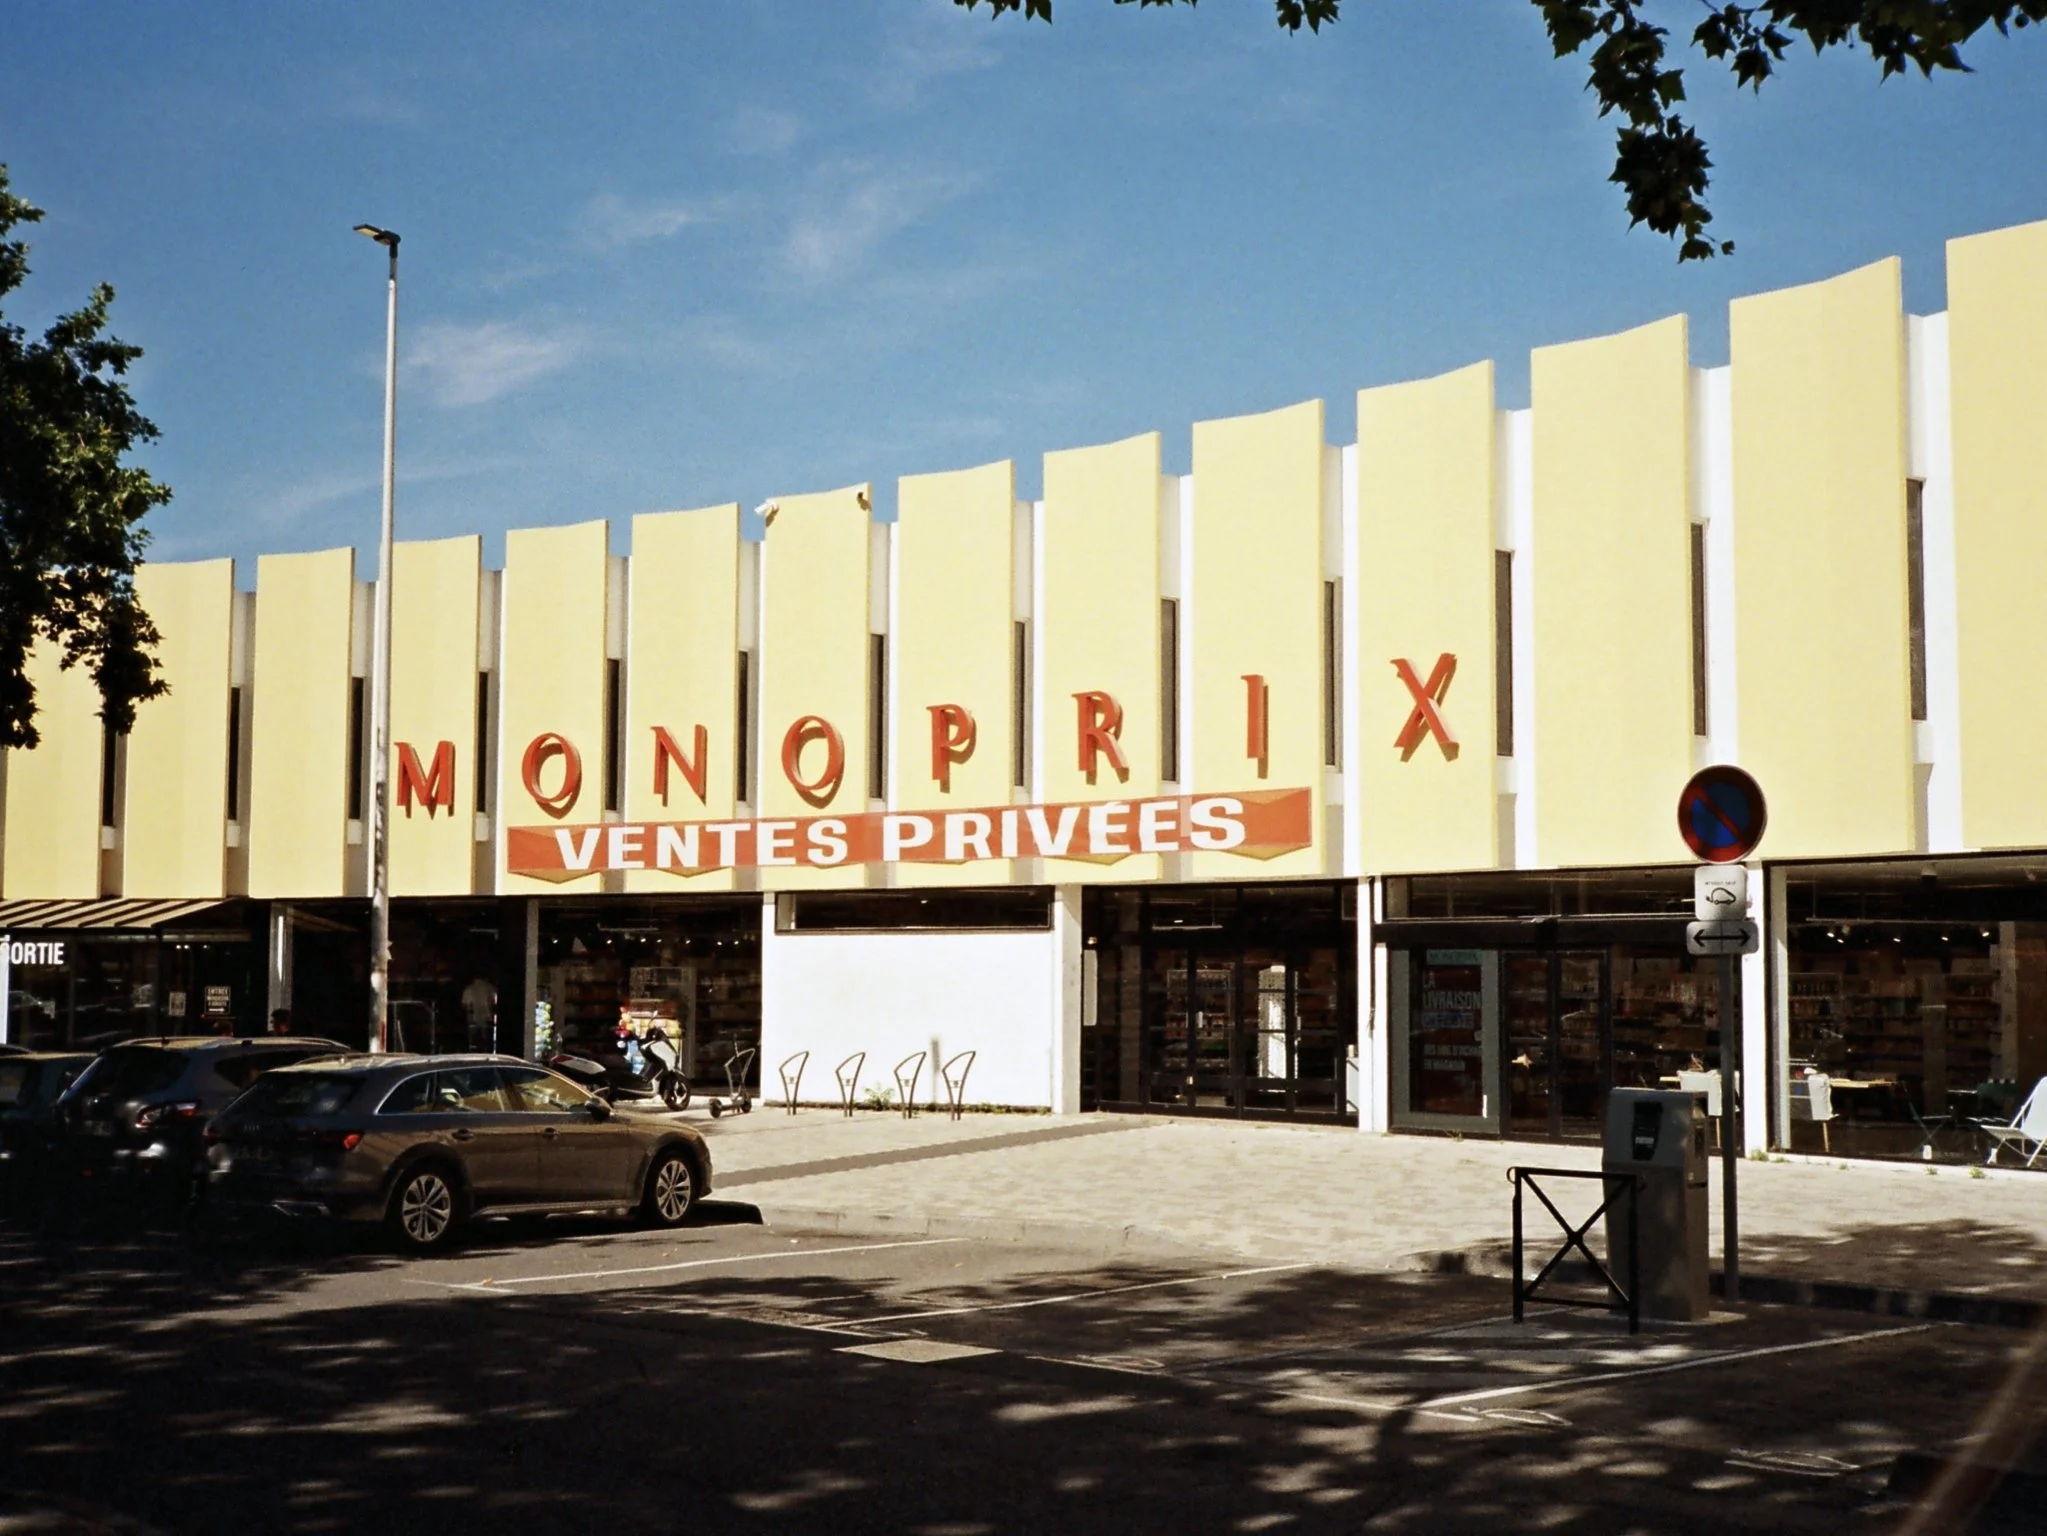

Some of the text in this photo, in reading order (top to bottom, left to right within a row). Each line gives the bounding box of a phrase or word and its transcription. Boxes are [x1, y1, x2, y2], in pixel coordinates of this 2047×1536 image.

[394, 652, 1459, 819] MONOPRIX
[555, 796, 1246, 872] VENTES PRIVÉES
[1422, 990, 1481, 1010] LIVRAISON
